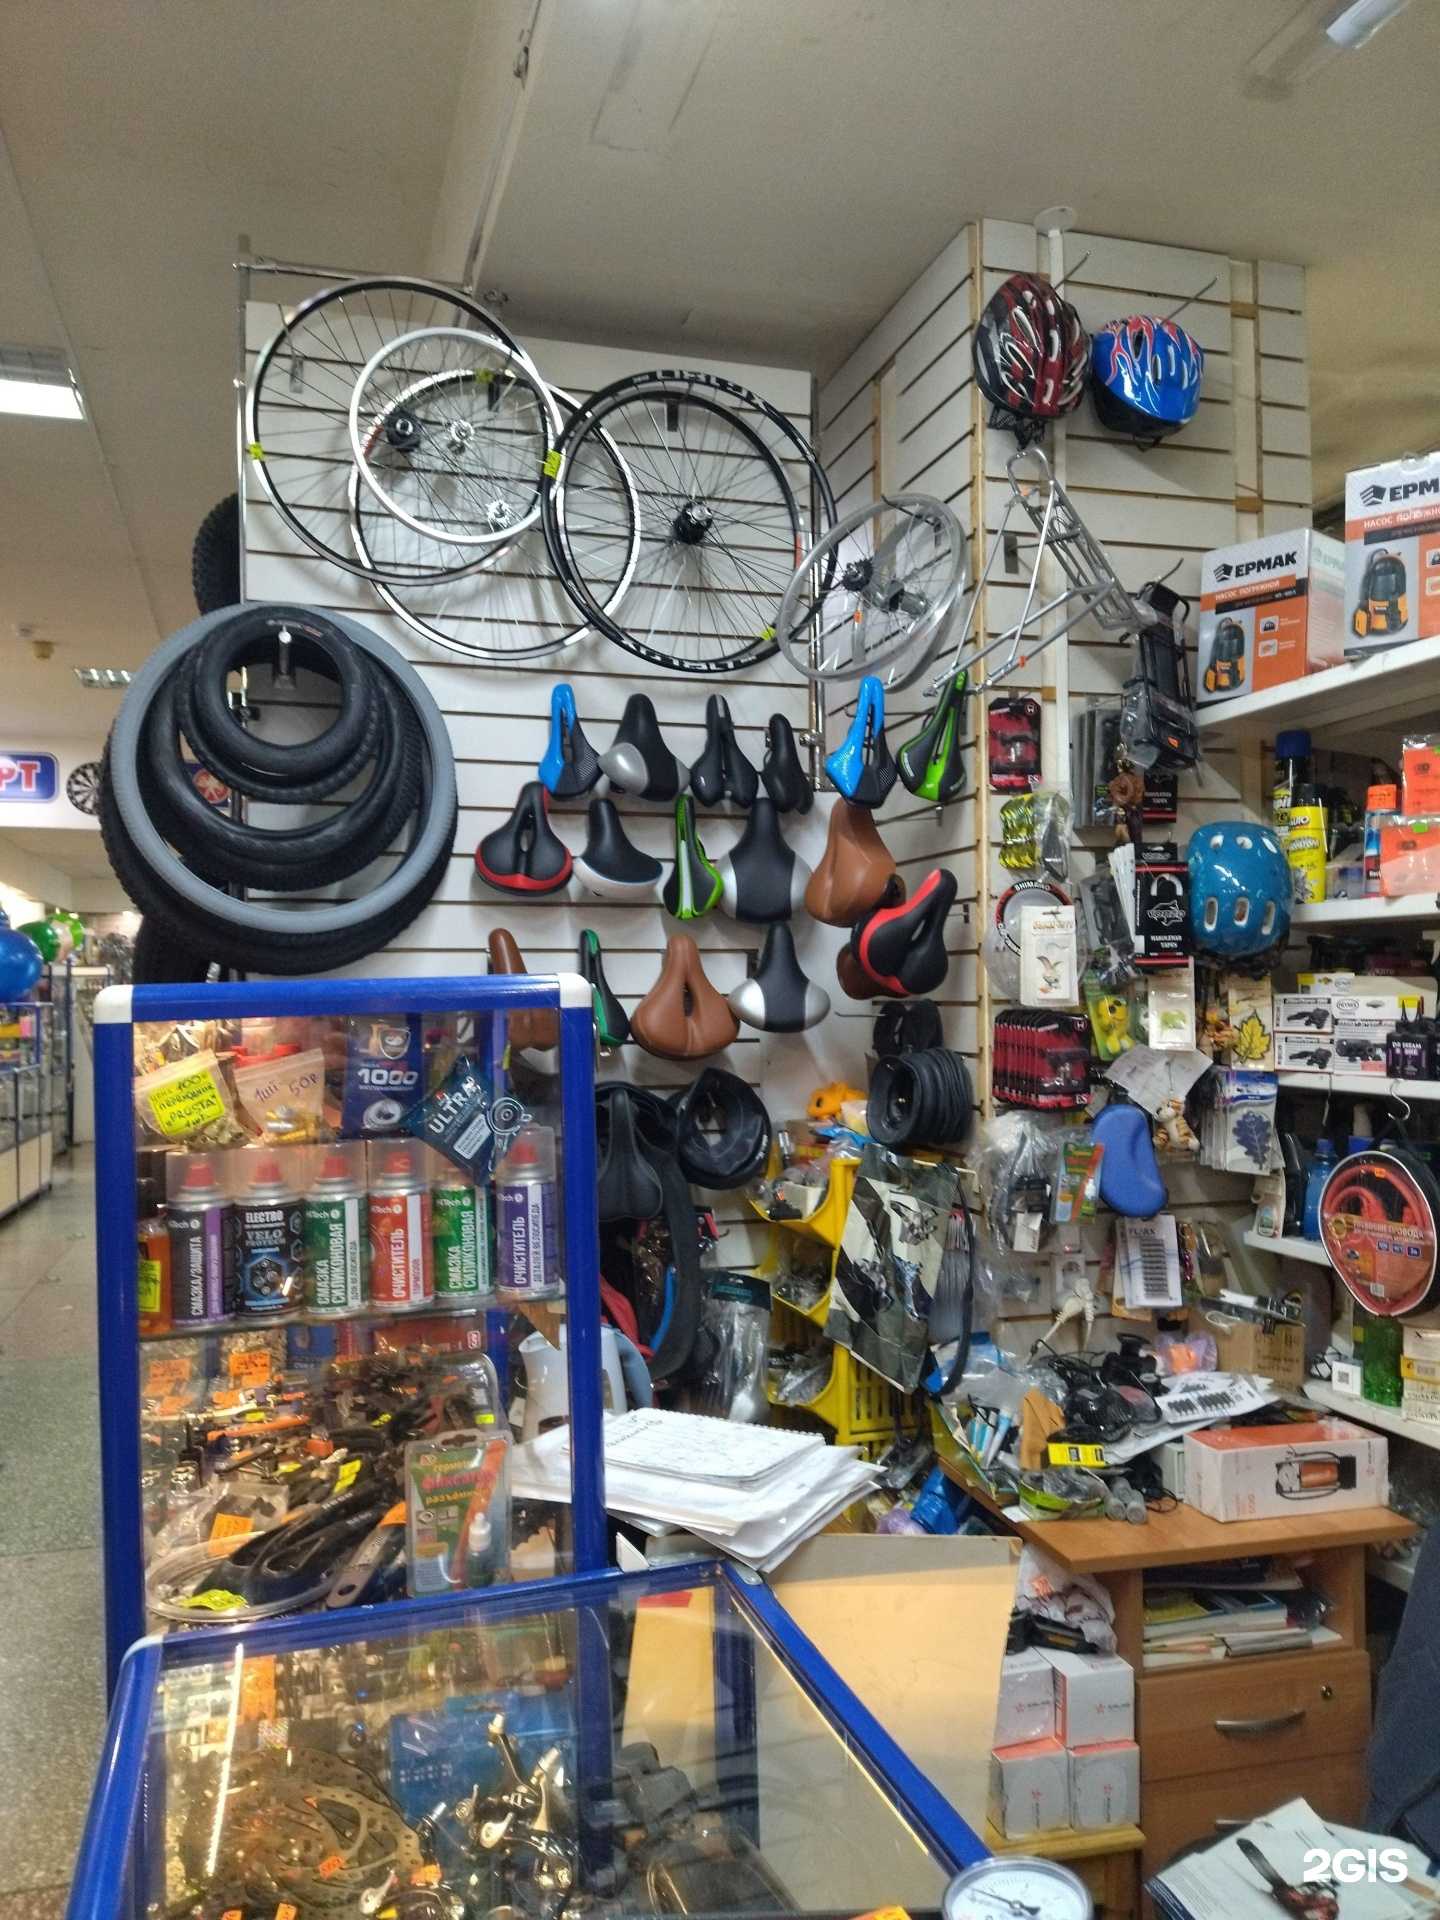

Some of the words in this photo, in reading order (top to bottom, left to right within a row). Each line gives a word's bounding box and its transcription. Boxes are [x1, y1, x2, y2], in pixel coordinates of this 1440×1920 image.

[1363, 515, 1393, 529] НАСОС
[1235, 551, 1297, 578] ЕРМАК
[1215, 589, 1239, 601] НАСОС
[358, 1068, 418, 1086] 1000
[245, 1210, 284, 1223] ELECTRO
[246, 1229, 283, 1241] VELO
[329, 1223, 346, 1304] СИЛИКОНОВАЯ
[390, 1228, 406, 1298] ОЧИСТИТЕЛЬ
[447, 1245, 462, 1289] СМАЗКА
[461, 1210, 477, 1288] СИЛИКОНОВАЯ
[511, 1216, 527, 1285] ОЧИСТИТЕЛЬ
[189, 1236, 203, 1317] СМАЗКА/ЗАЩИТА
[315, 1259, 330, 1305] СМАЗКА
